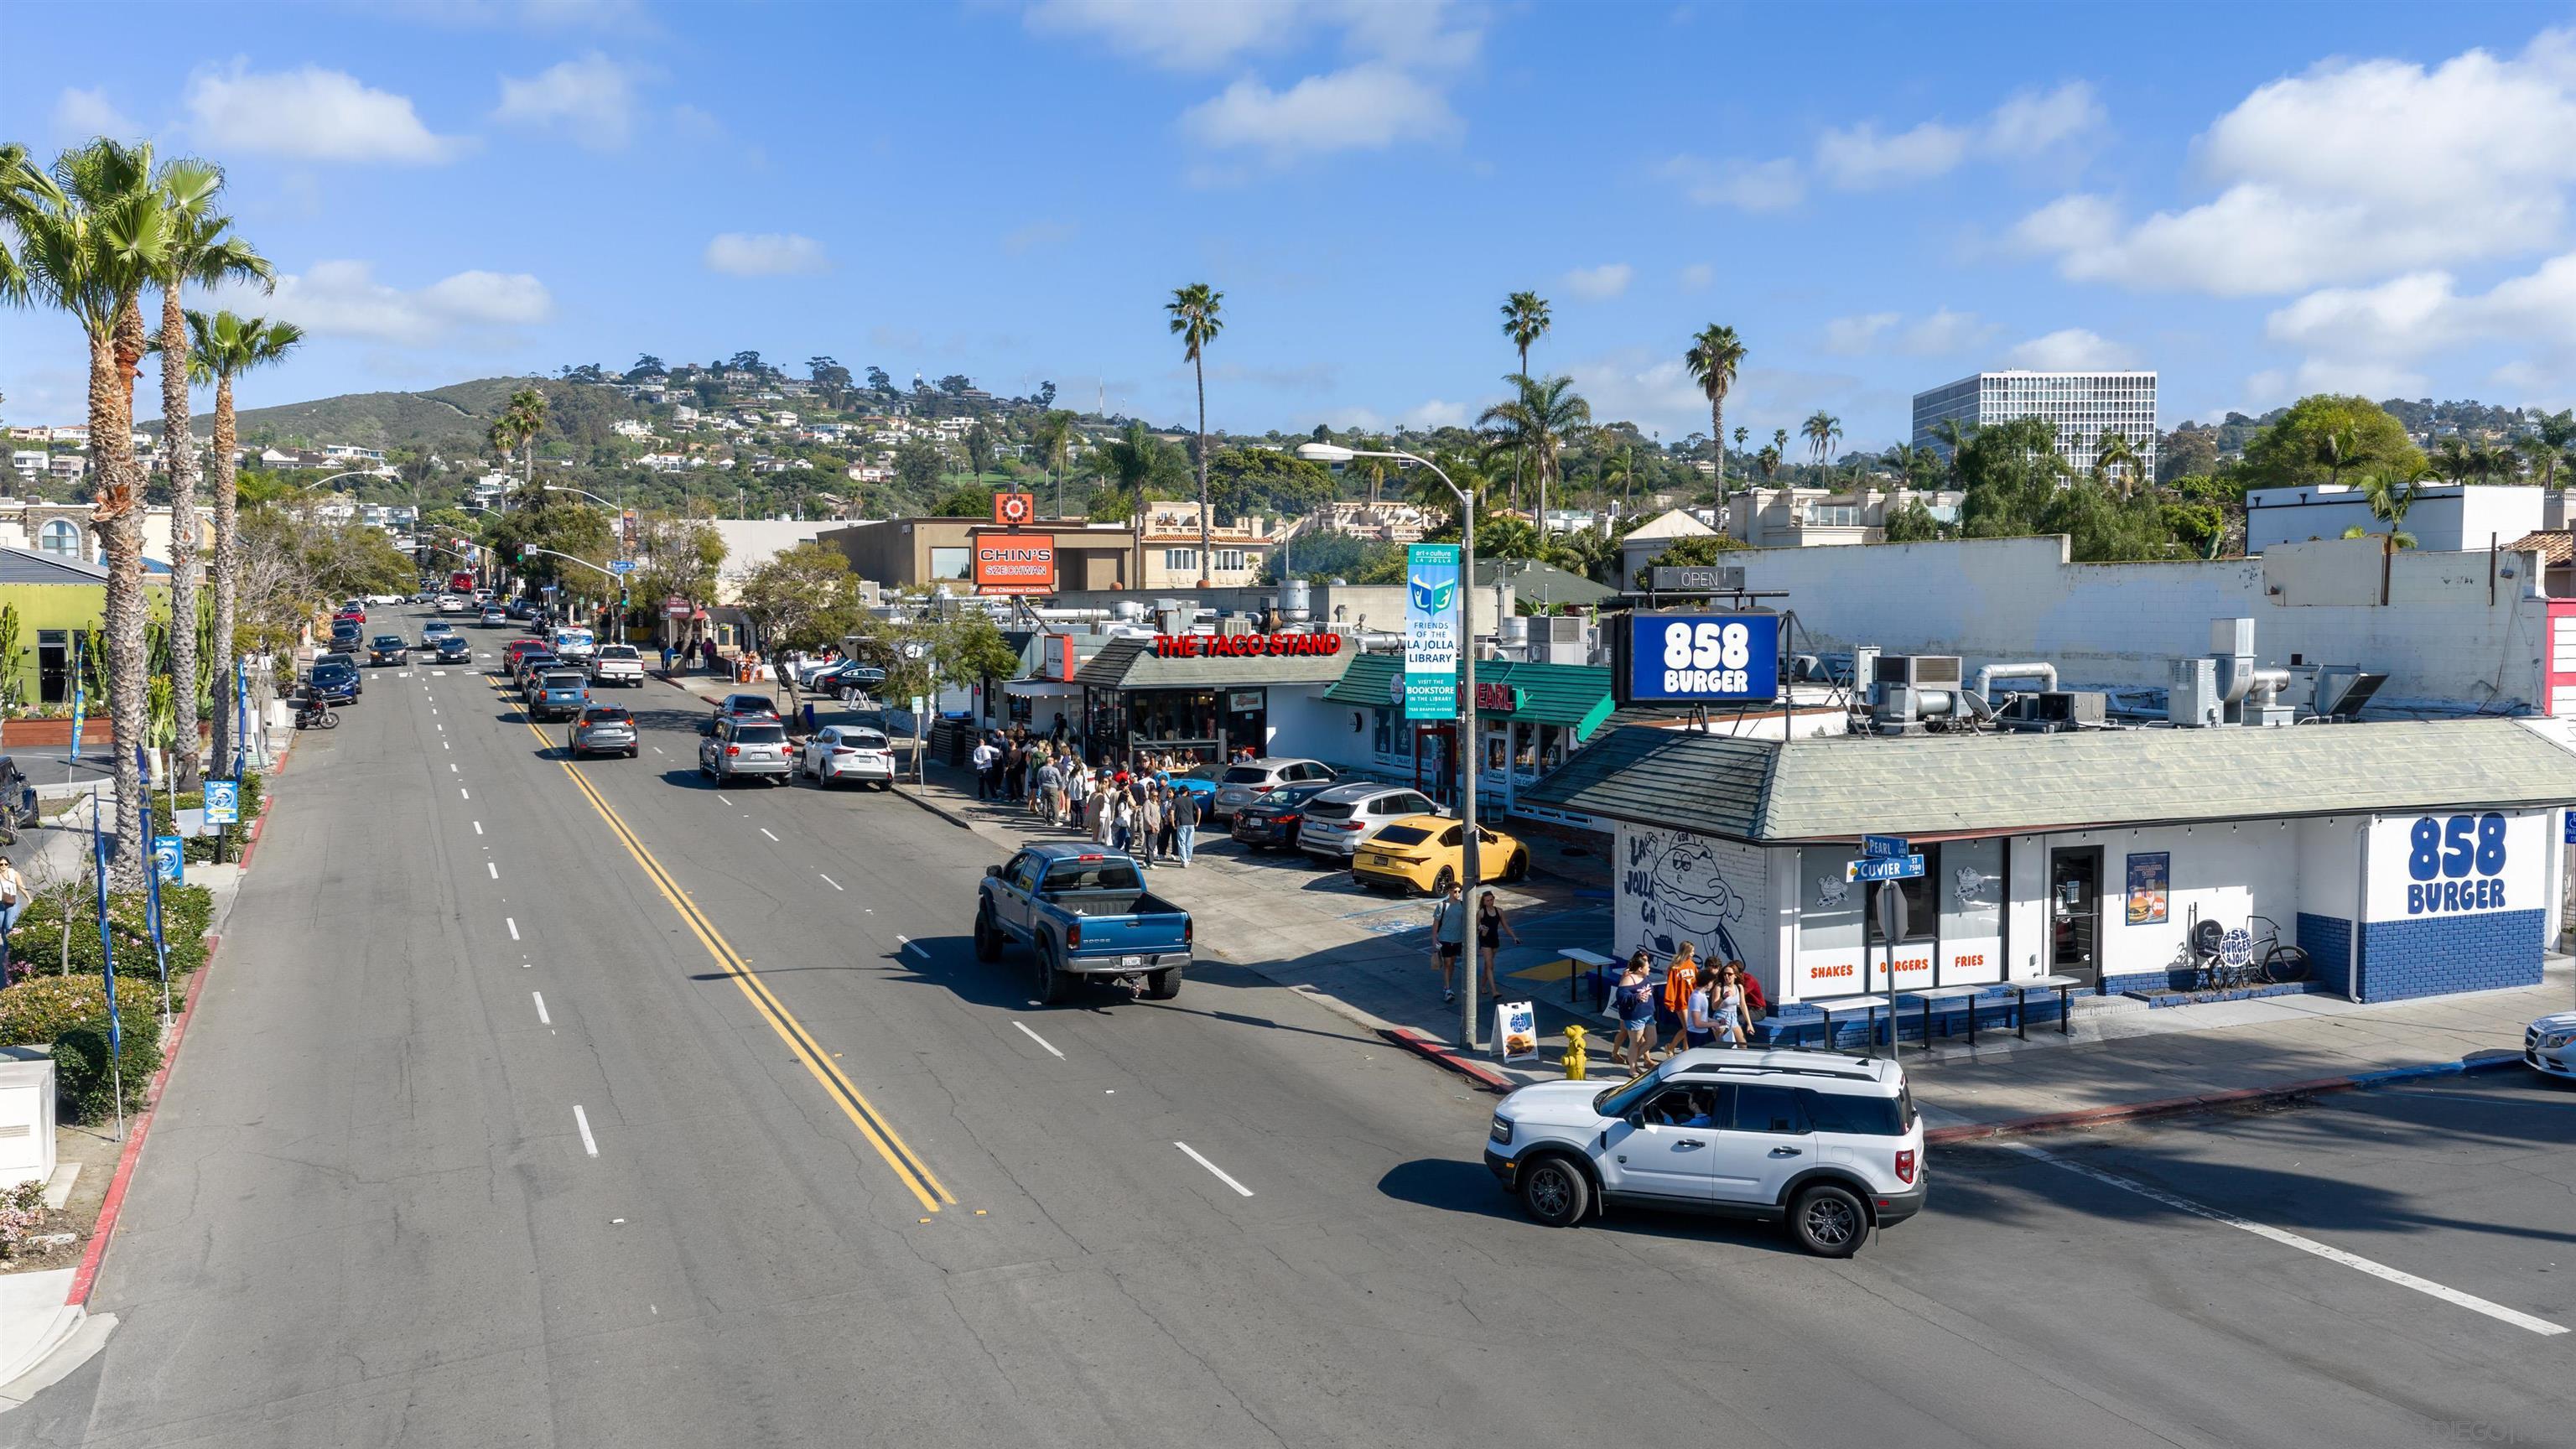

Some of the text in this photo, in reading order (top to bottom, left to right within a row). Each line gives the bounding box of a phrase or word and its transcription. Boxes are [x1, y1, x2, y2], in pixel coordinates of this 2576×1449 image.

[979, 548, 1052, 562] CHIN'S
[986, 564, 1047, 575] SZECHWAN
[1681, 572, 1718, 587] OPEN
[1414, 621, 1449, 630] FRIENDS
[1154, 632, 1341, 656] THE TACO STAND
[1407, 640, 1454, 652] LA JOLLA
[1664, 622, 1749, 670] 858
[1409, 653, 1452, 663] LIBRARY
[1664, 669, 1748, 693] BURGER
[1406, 686, 1455, 694] BOOKSTORE
[1475, 682, 1513, 711] EARL
[1629, 836, 1646, 867] LA
[1869, 839, 1892, 855] PEARL
[2408, 812, 2507, 881] 858
[1860, 862, 1901, 877] CUVIER
[1623, 870, 1655, 901] JOLLA
[2407, 878, 2506, 915] BURGER
[1641, 901, 1656, 927] CA
[2222, 929, 2248, 942] 858
[2220, 938, 2252, 955] BURGER
[1880, 958, 1929, 974] BRGERS
[1955, 954, 1984, 968] FRIES
[1810, 964, 1853, 979] SHAKES
